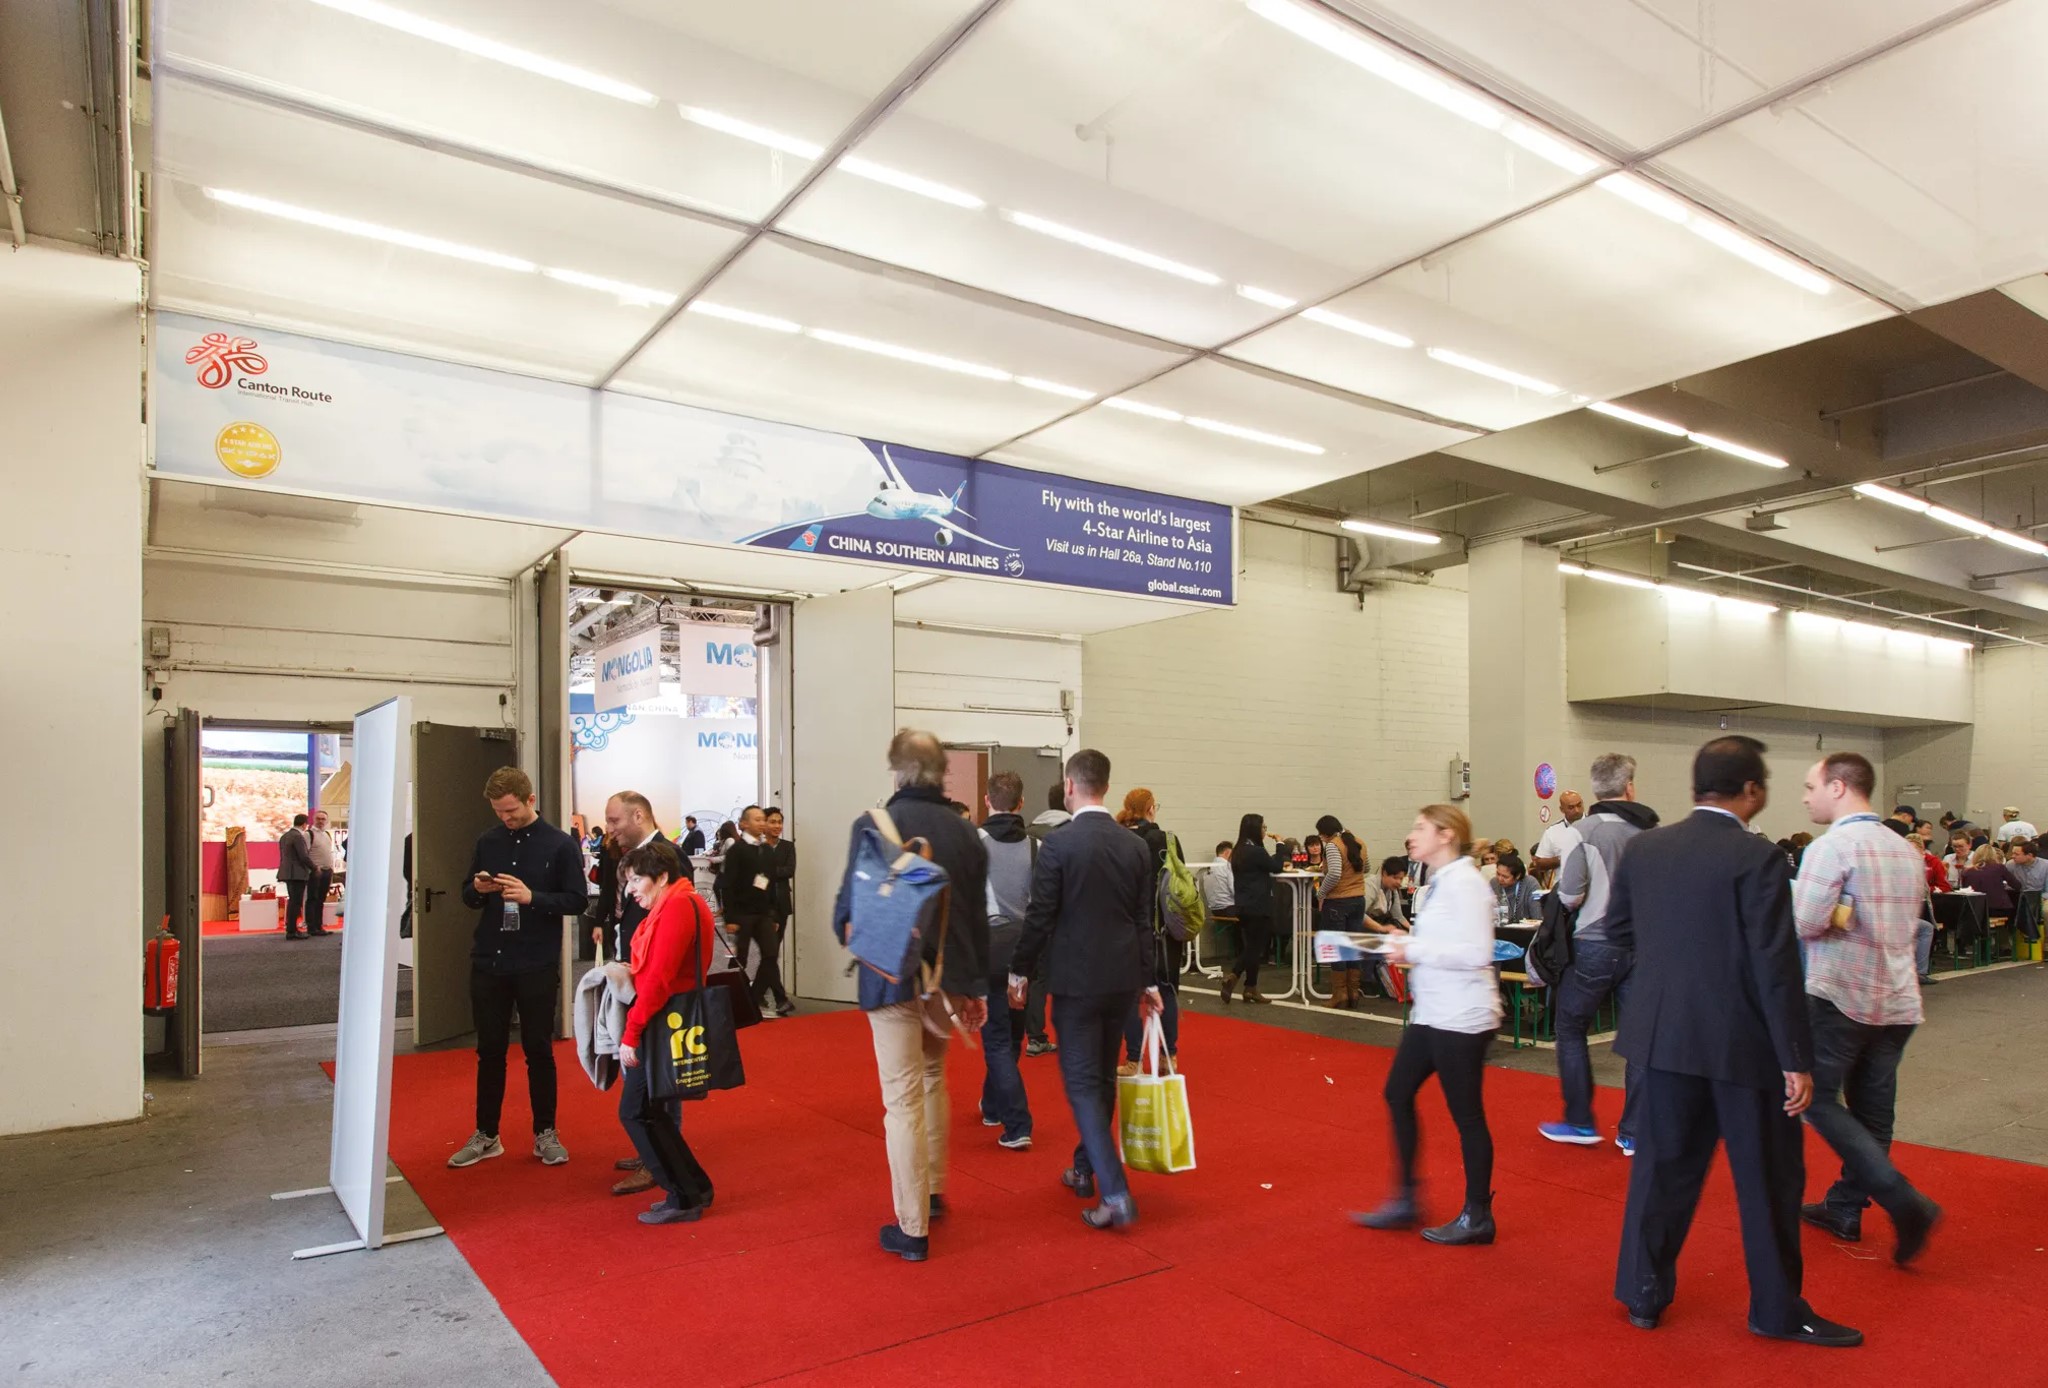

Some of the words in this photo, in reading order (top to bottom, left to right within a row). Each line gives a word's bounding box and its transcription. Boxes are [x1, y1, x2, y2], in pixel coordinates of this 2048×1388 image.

[237, 377, 288, 396] Canton
[292, 386, 332, 403] Route
[1042, 489, 1062, 512] Fly
[1065, 497, 1094, 514] with
[1097, 501, 1120, 518] the
[1122, 507, 1167, 526] world's
[1170, 512, 1211, 534] largest
[828, 534, 872, 554] CHINA
[875, 541, 945, 564] SOUTHERN
[948, 551, 1000, 571] AIRLINES
[1082, 519, 1124, 540] 4-Star
[1126, 526, 1169, 547] Airline
[1171, 536, 1185, 549] to
[1187, 538, 1213, 554] Asia
[1046, 538, 1069, 553] Visit
[1071, 544, 1085, 556] us
[1087, 543, 1097, 557] in
[1099, 546, 1120, 561] Hall
[1122, 549, 1144, 566] 26a,
[1147, 553, 1176, 569] Stand
[1177, 557, 1212, 574] No.110
[1147, 579, 1222, 598] global.csair.com
[601, 646, 653, 683] MONGOLIA
[698, 731, 758, 749] MON
